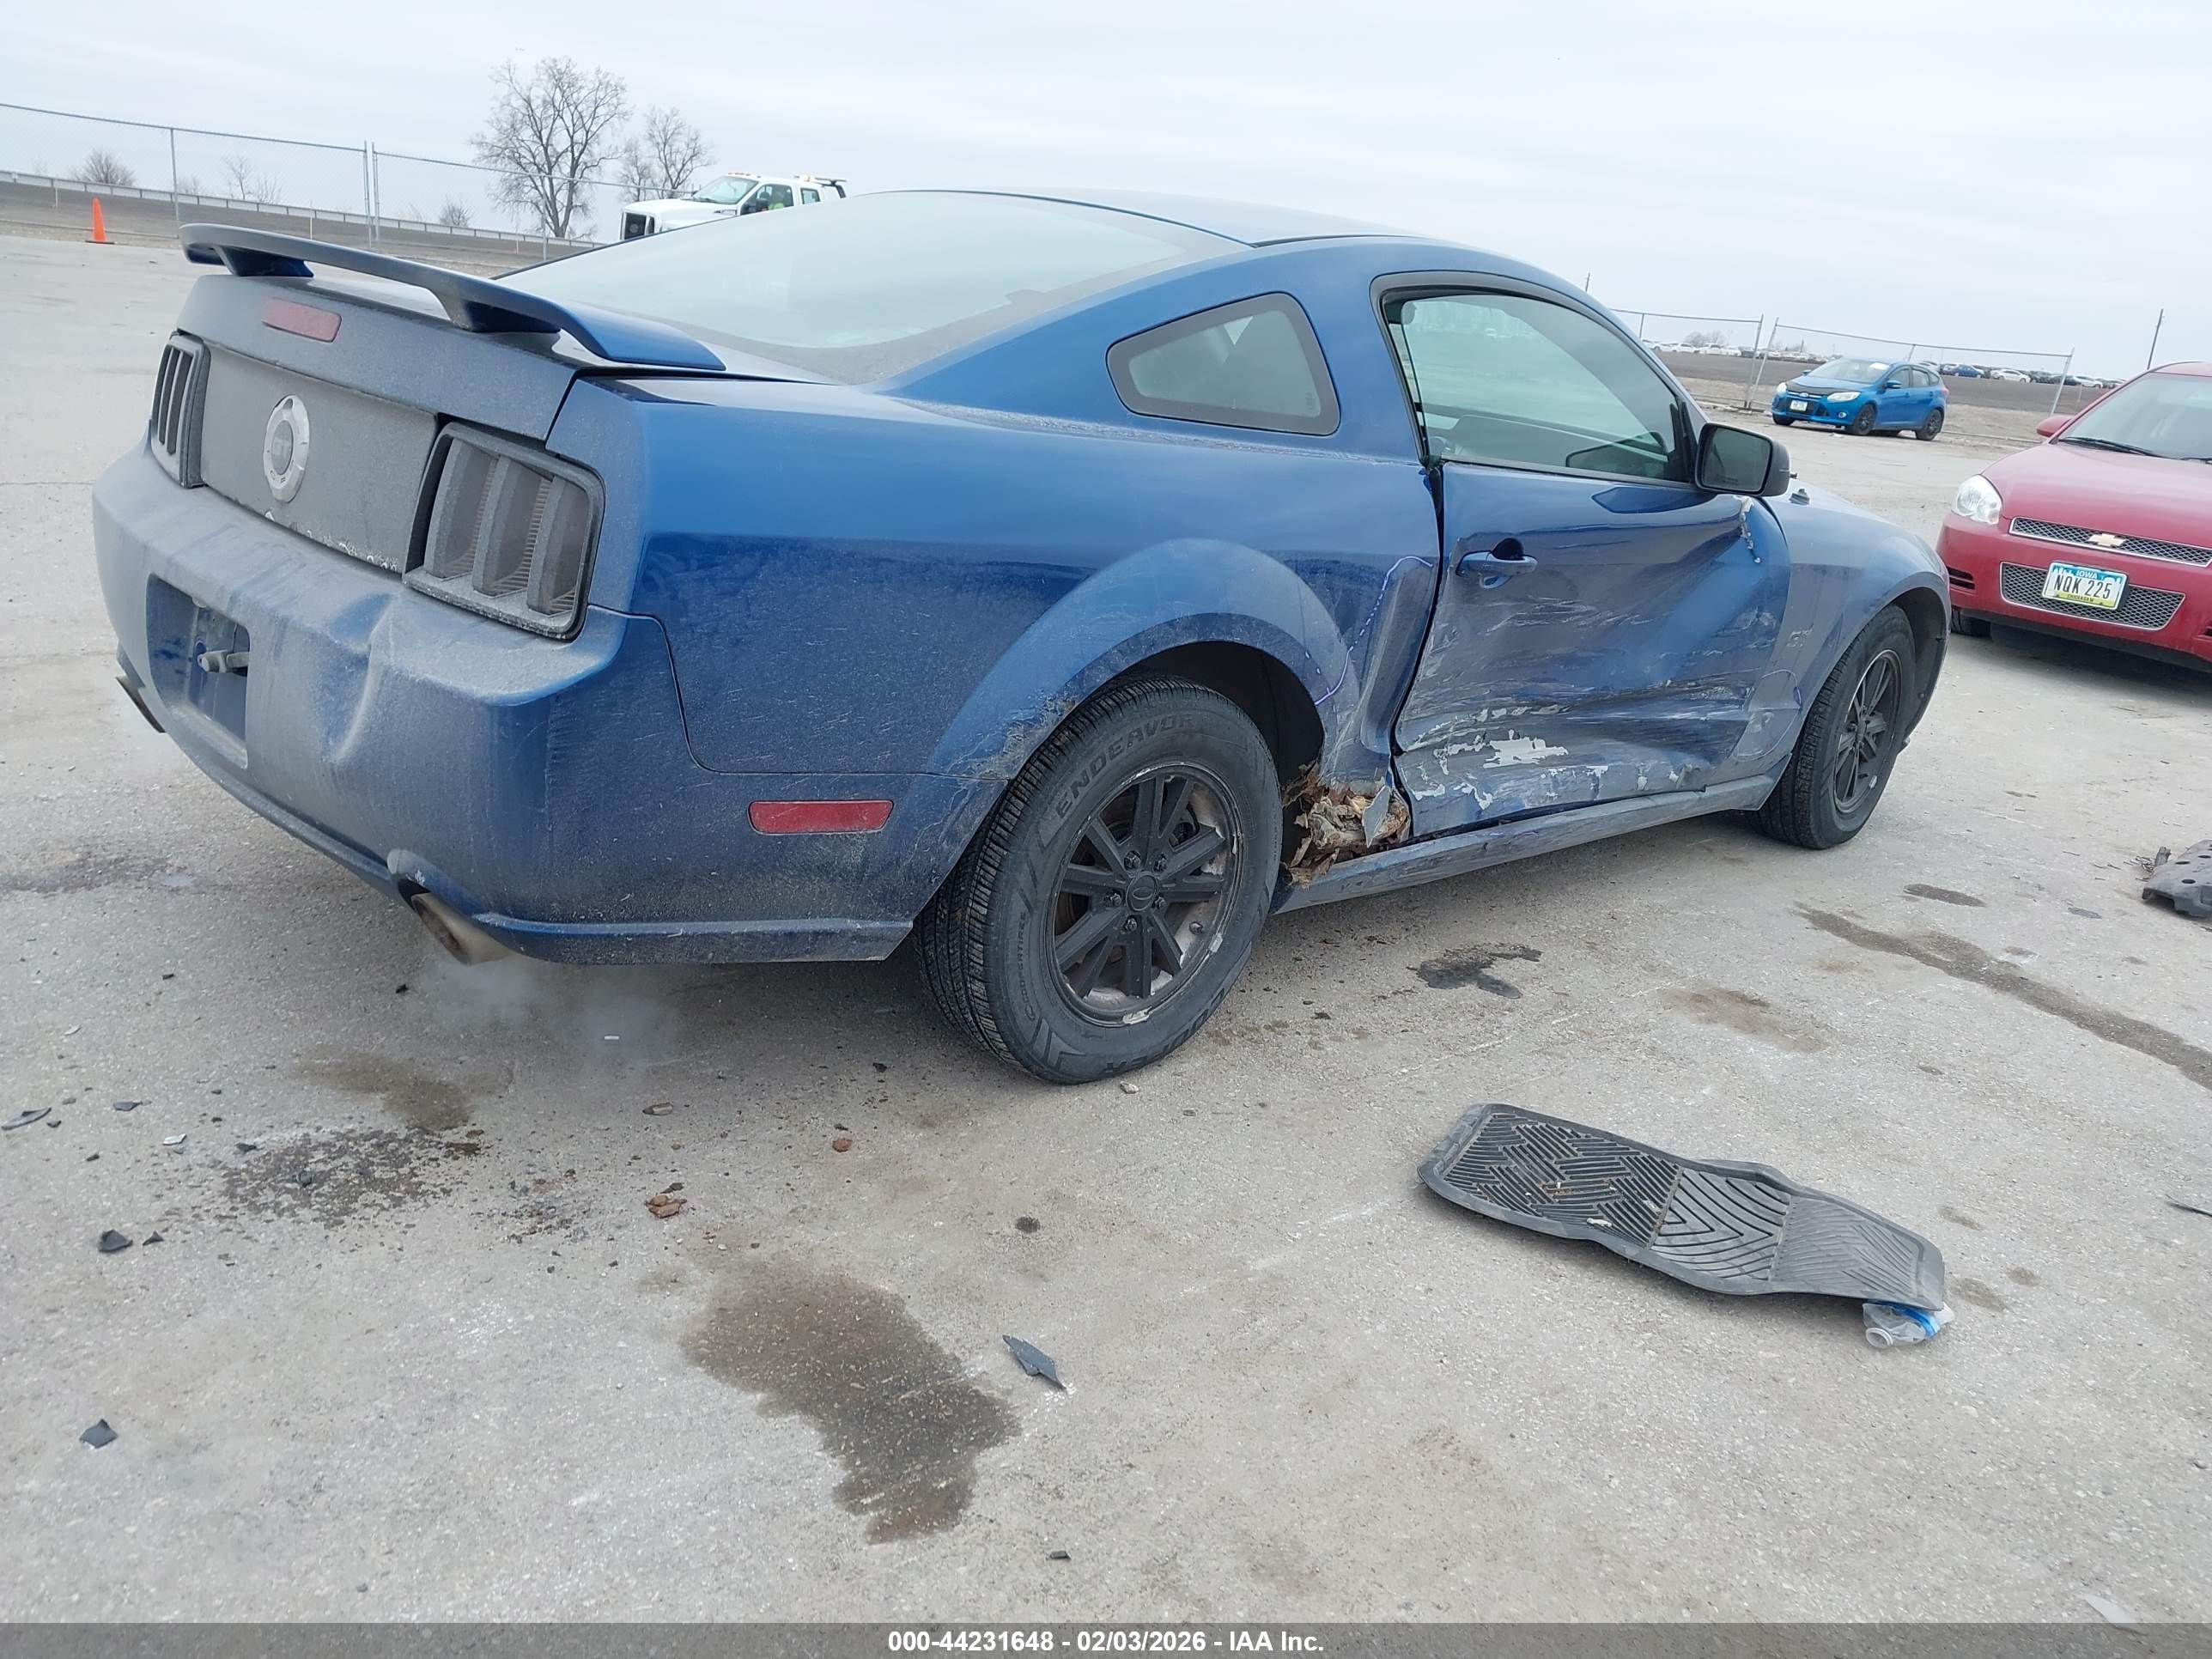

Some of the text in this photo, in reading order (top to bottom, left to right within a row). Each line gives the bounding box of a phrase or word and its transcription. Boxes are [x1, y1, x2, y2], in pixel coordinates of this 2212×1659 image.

[2076, 569, 2097, 580] IOWA
[2054, 574, 2112, 599] NQK 225
